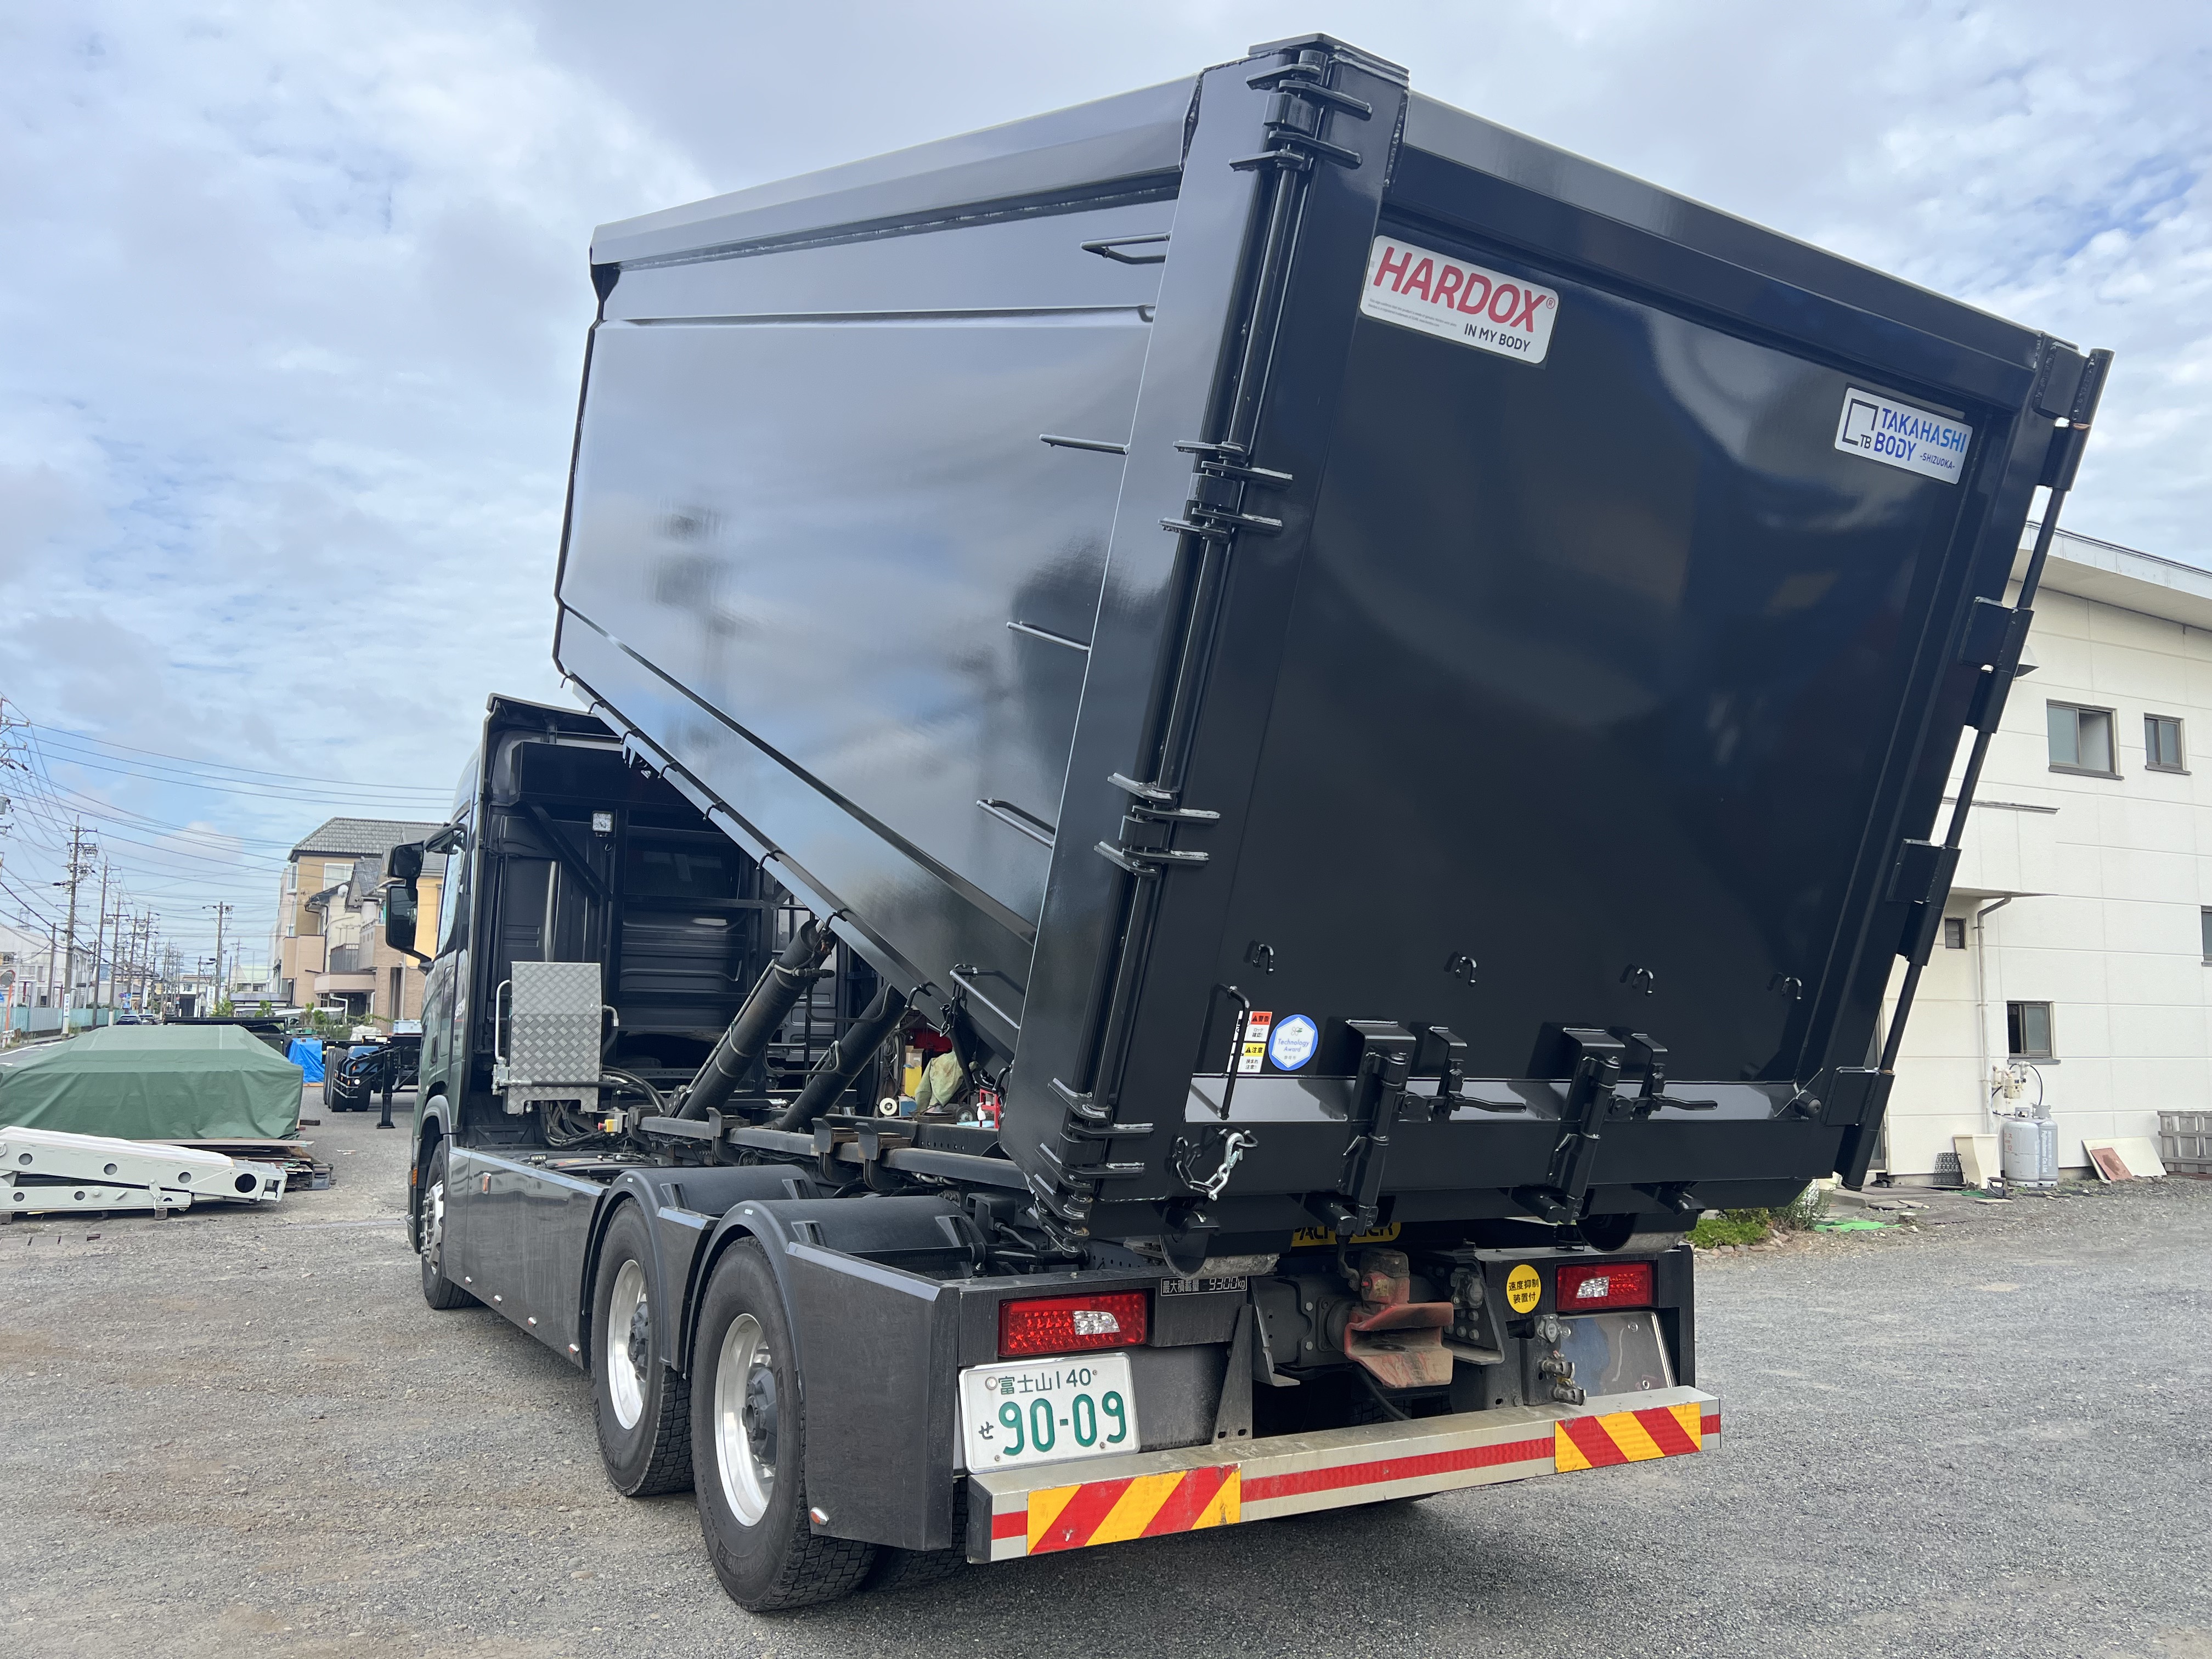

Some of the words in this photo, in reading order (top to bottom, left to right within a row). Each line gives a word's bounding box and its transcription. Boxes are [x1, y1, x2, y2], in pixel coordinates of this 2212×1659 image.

[1464, 323, 1477, 337] IN
[1479, 328, 1498, 342] MY
[1499, 333, 1531, 352] BODY
[1882, 408, 1967, 453] TAKAHASHI
[1860, 434, 1872, 449] TB
[1874, 432, 1917, 461] BODY
[1278, 1039, 1310, 1047] Technology
[1163, 1279, 1199, 1294] 最大積載量
[1509, 1278, 1539, 1291] 速度抑制
[1513, 1291, 1536, 1304] 装置付
[978, 1421, 994, 1441] せ
[998, 1390, 1127, 1456] 90-09
